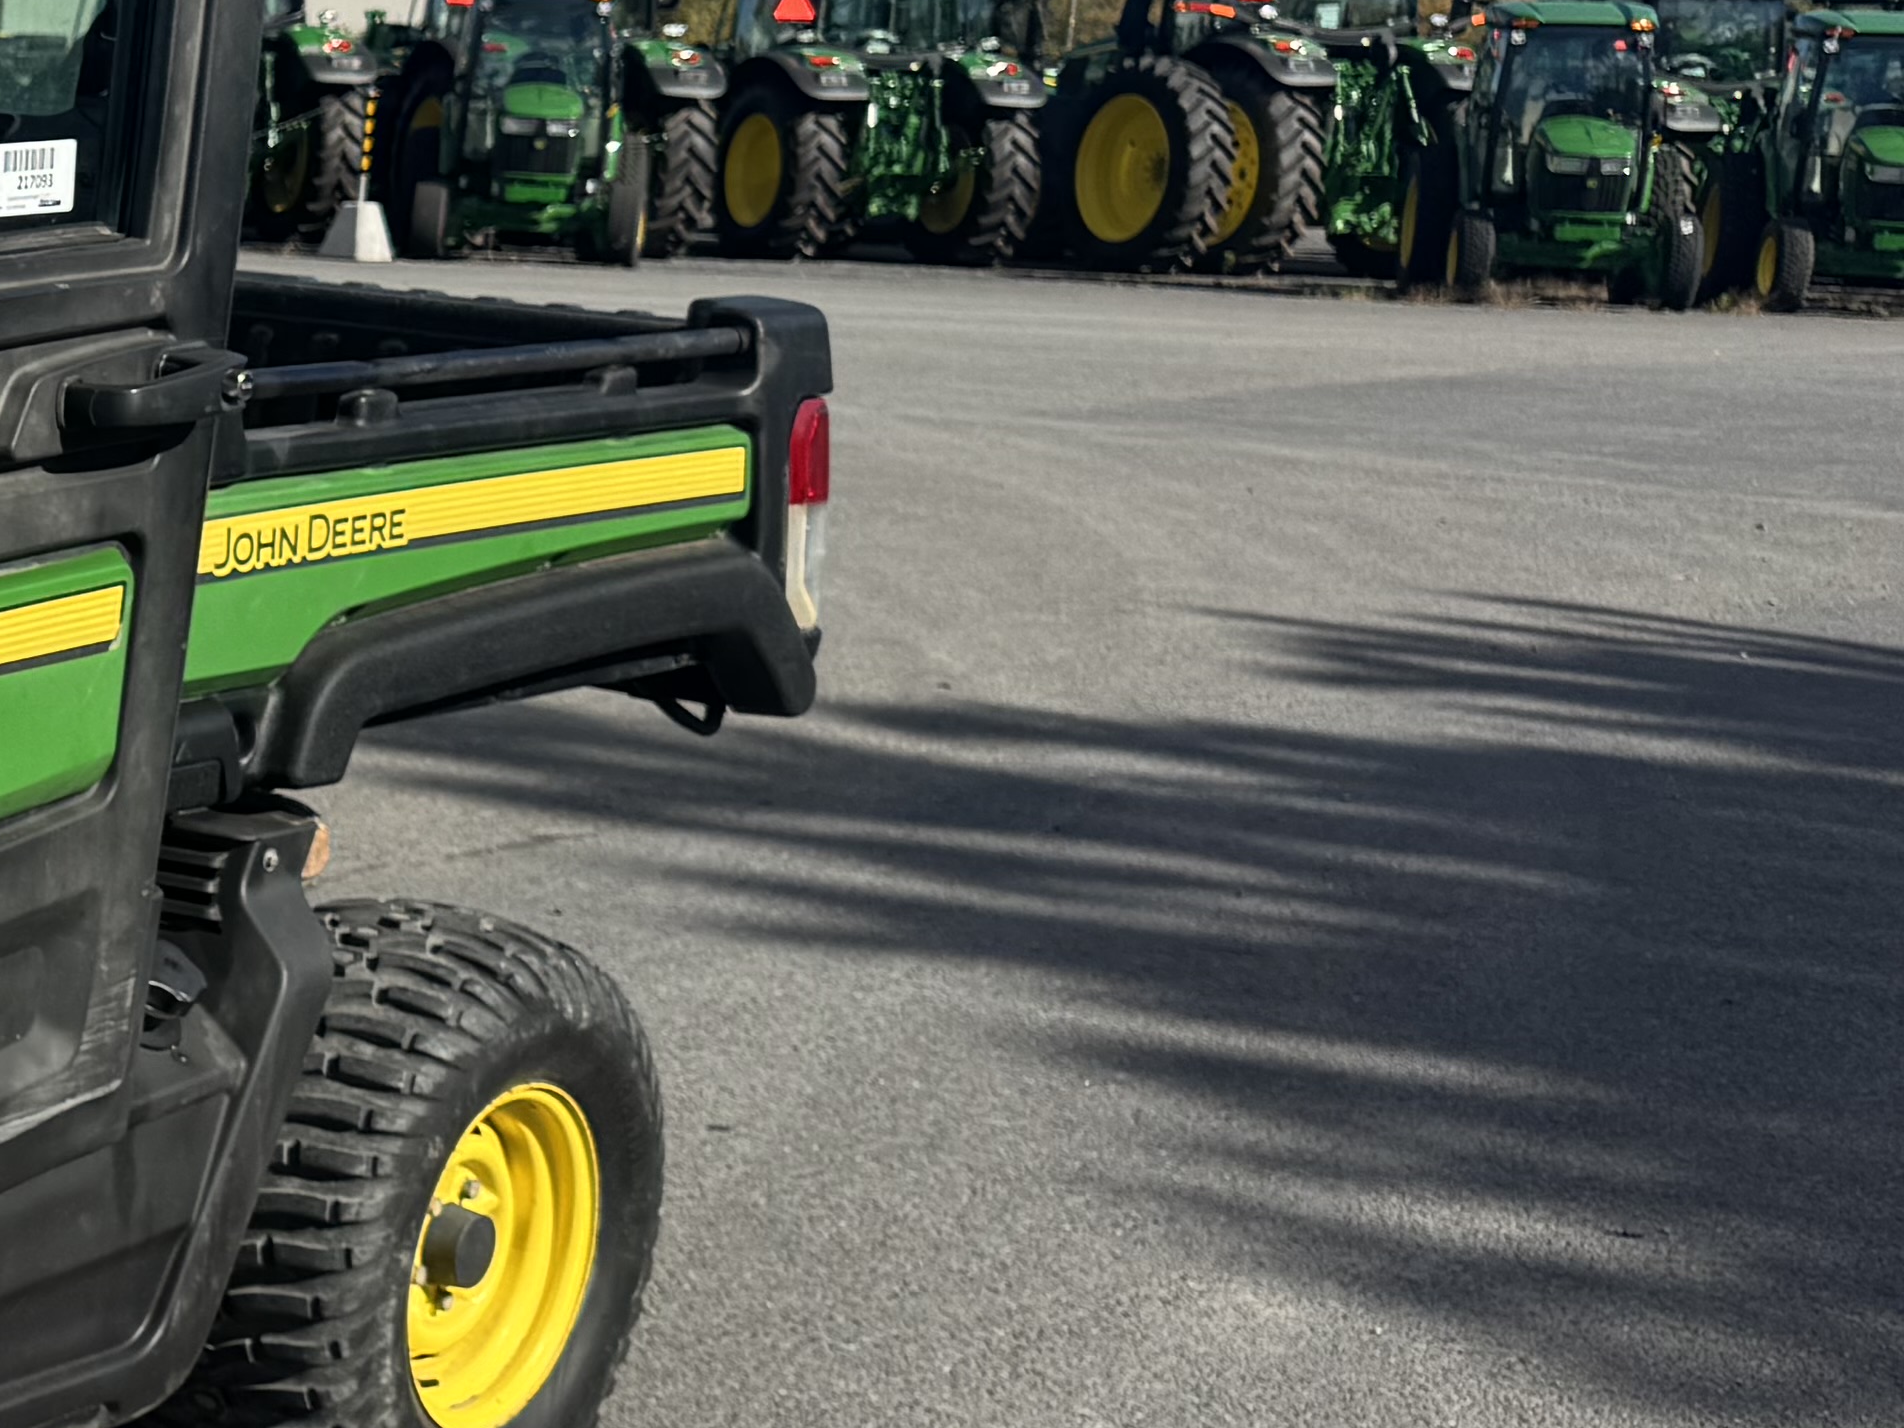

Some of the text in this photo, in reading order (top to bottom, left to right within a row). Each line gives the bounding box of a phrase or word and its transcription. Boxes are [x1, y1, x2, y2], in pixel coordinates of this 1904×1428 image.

[17, 174, 53, 190] 217093
[213, 508, 406, 570] JOHN DEERE
